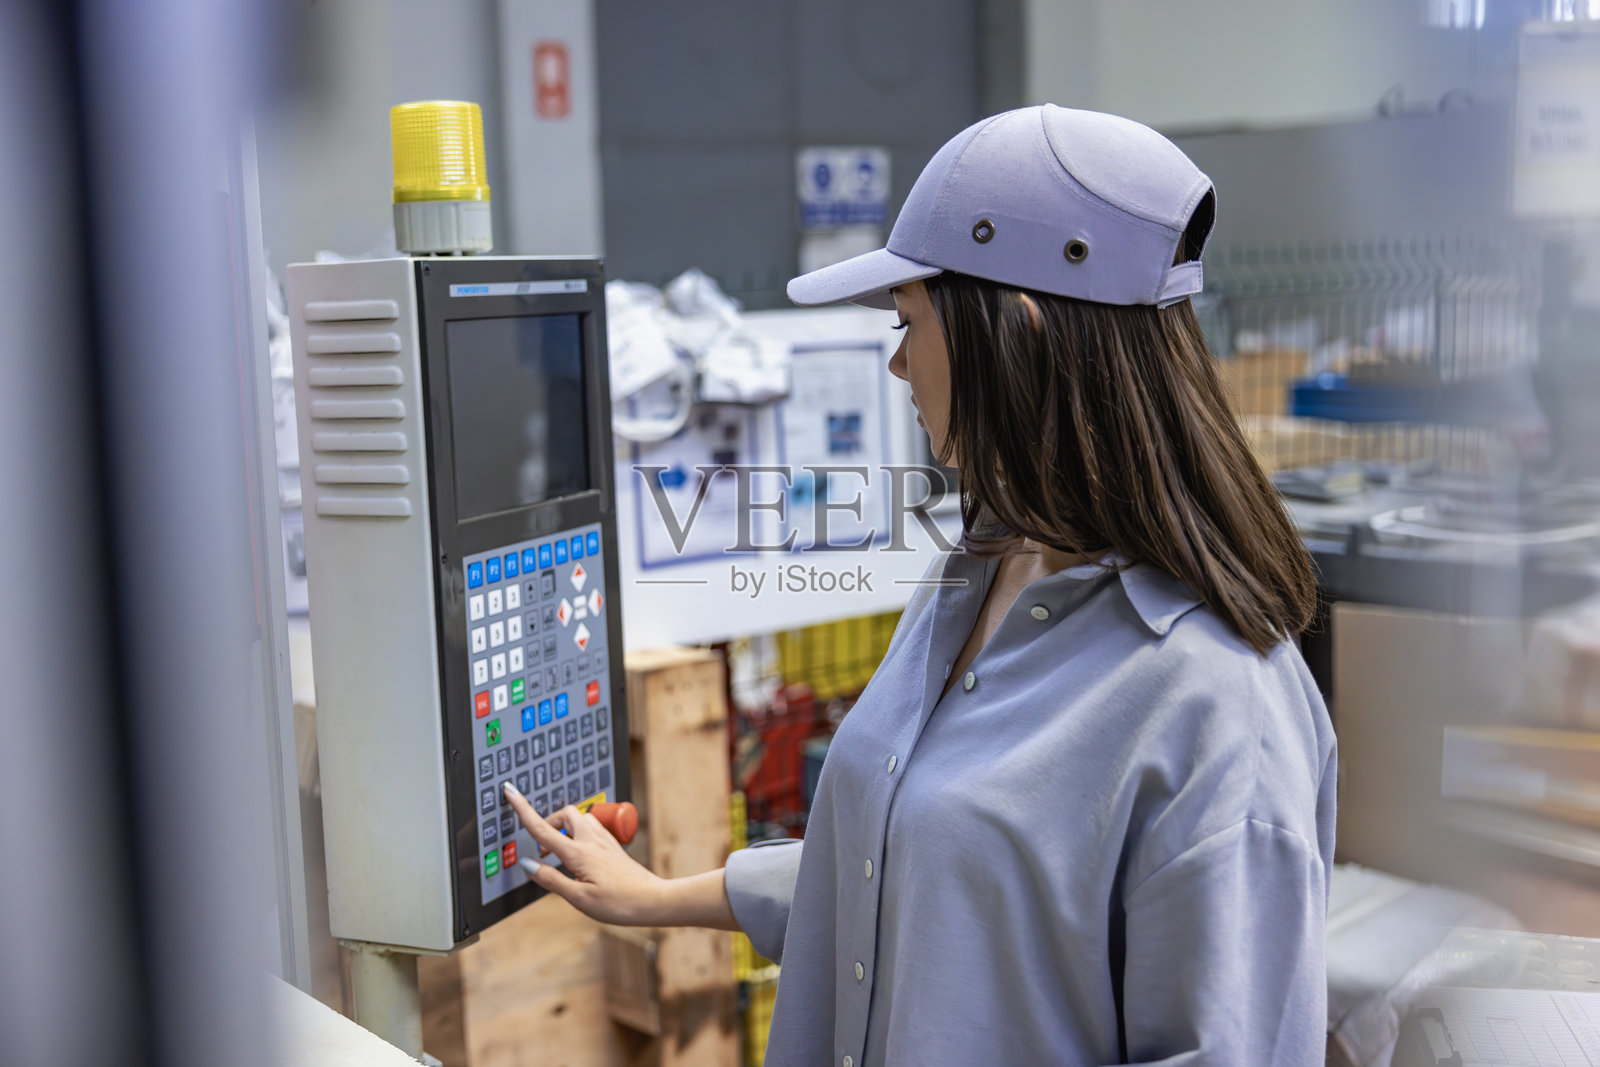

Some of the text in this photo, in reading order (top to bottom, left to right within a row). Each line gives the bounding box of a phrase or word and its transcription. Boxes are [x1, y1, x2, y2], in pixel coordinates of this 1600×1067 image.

[472, 569, 480, 581] F1
[490, 565, 499, 575] F2
[508, 560, 516, 570] F3
[525, 556, 534, 566] F4
